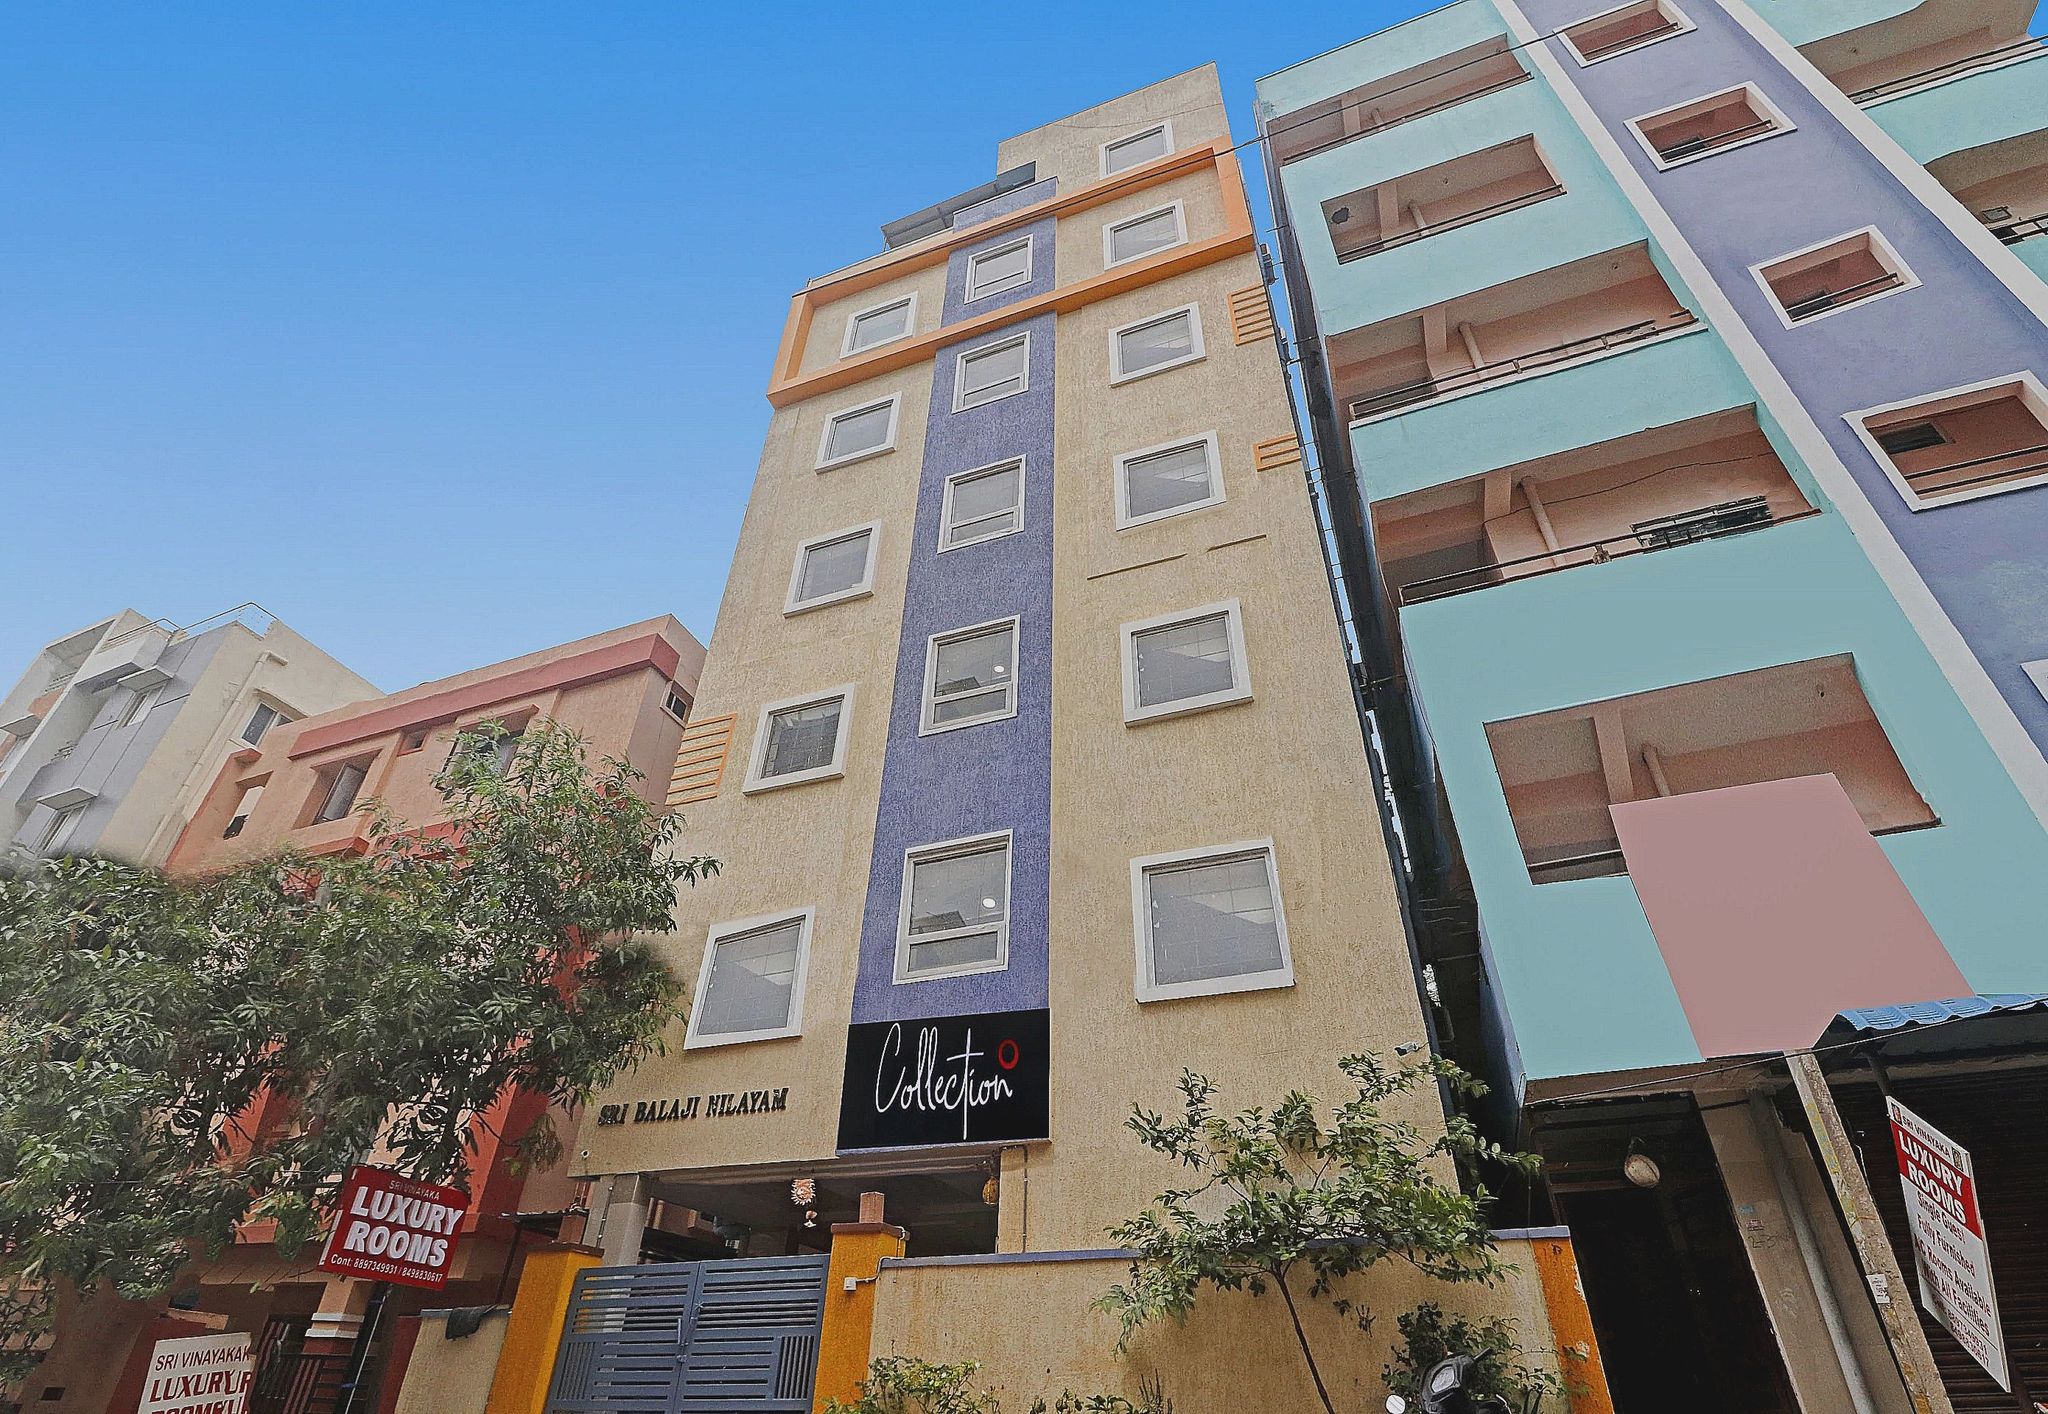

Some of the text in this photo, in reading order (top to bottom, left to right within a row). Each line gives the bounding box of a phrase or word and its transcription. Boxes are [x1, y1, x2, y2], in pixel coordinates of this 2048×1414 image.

[599, 1087, 789, 1125] SRI BALAJI NILAYAM
[875, 1022, 1013, 1141] Collection
[1902, 1115, 1914, 1131] SRI
[1898, 1129, 1963, 1197] LUXURY
[350, 1186, 464, 1236] LUXURY
[1907, 1159, 1966, 1224] ROOMS
[1917, 1189, 1941, 1224] Single
[343, 1220, 449, 1267] ROOMS
[1926, 1244, 1953, 1282] Rooms
[1953, 1270, 1992, 1319] Available
[1952, 1286, 1990, 1337] Facilities
[155, 1353, 179, 1371] SRI
